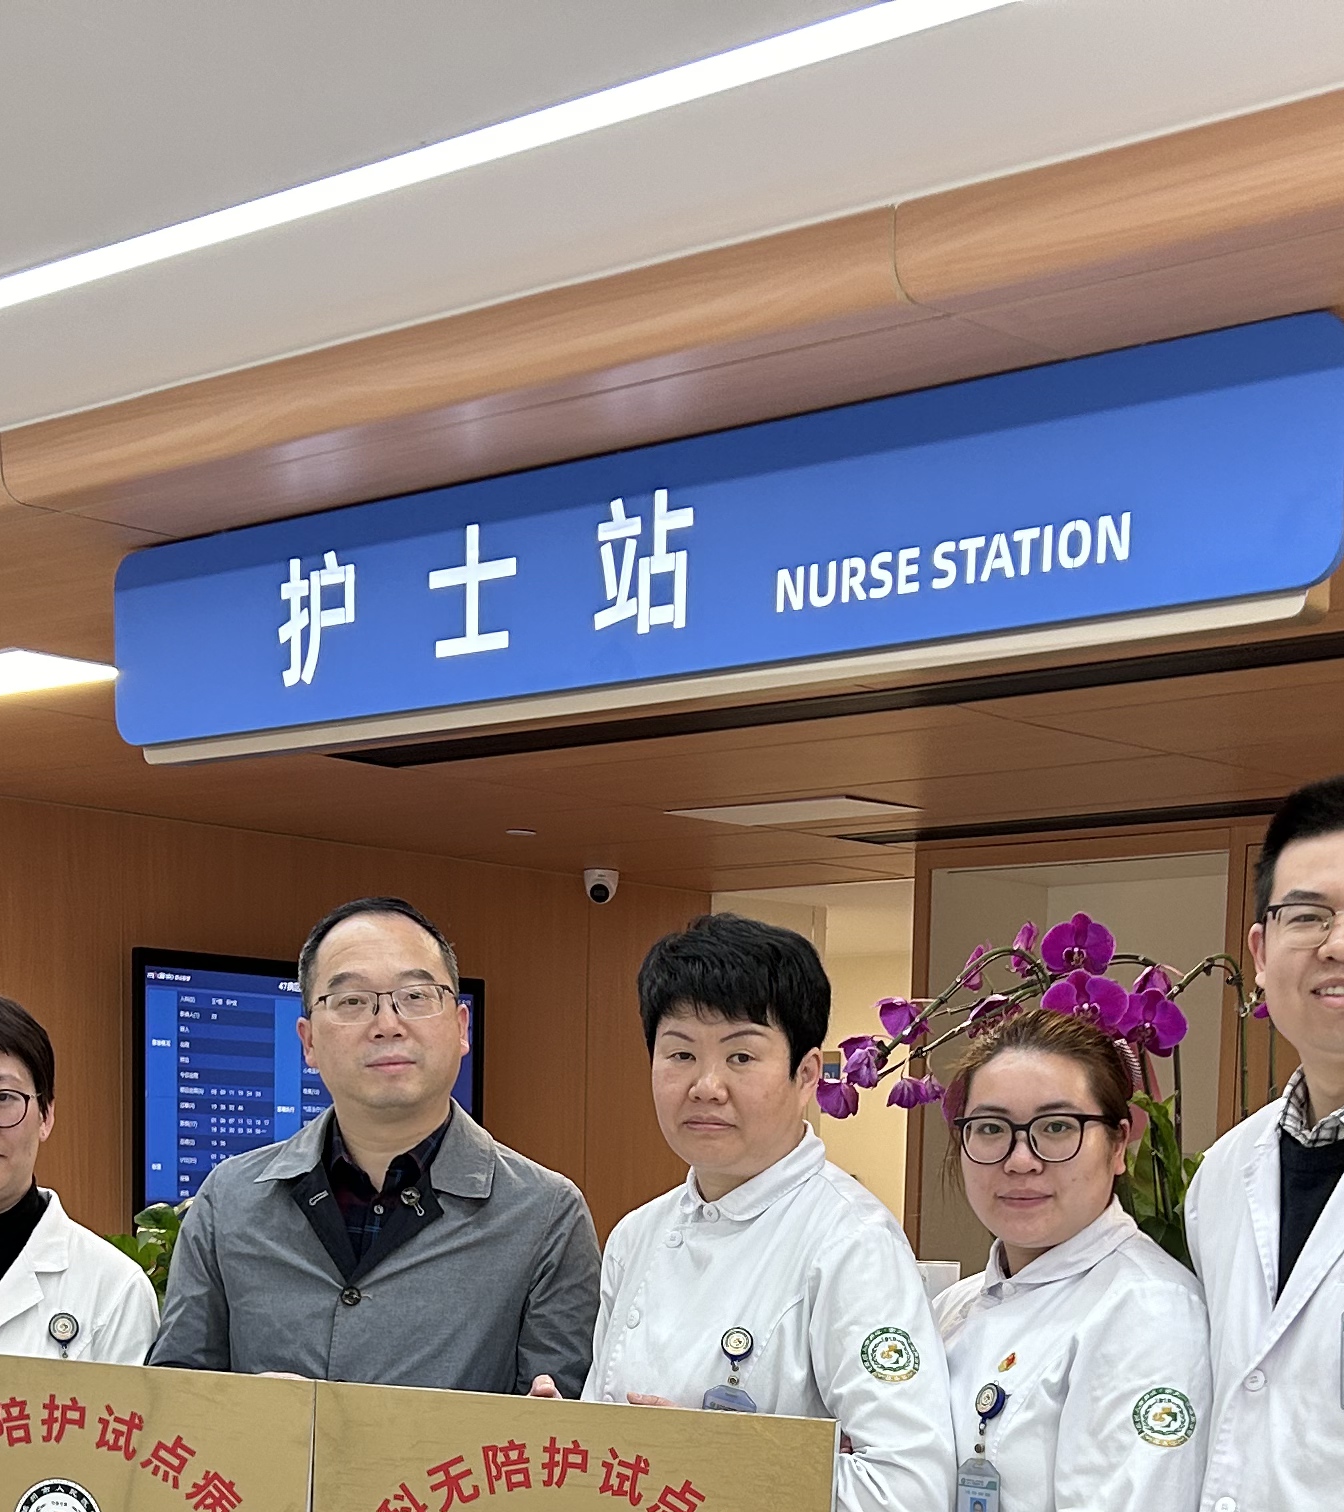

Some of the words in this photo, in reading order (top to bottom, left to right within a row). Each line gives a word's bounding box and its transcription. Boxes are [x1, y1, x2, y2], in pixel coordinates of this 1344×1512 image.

[278, 487, 695, 688] 护士站
[775, 546, 921, 614] NURSE
[931, 510, 1132, 590] STATION
